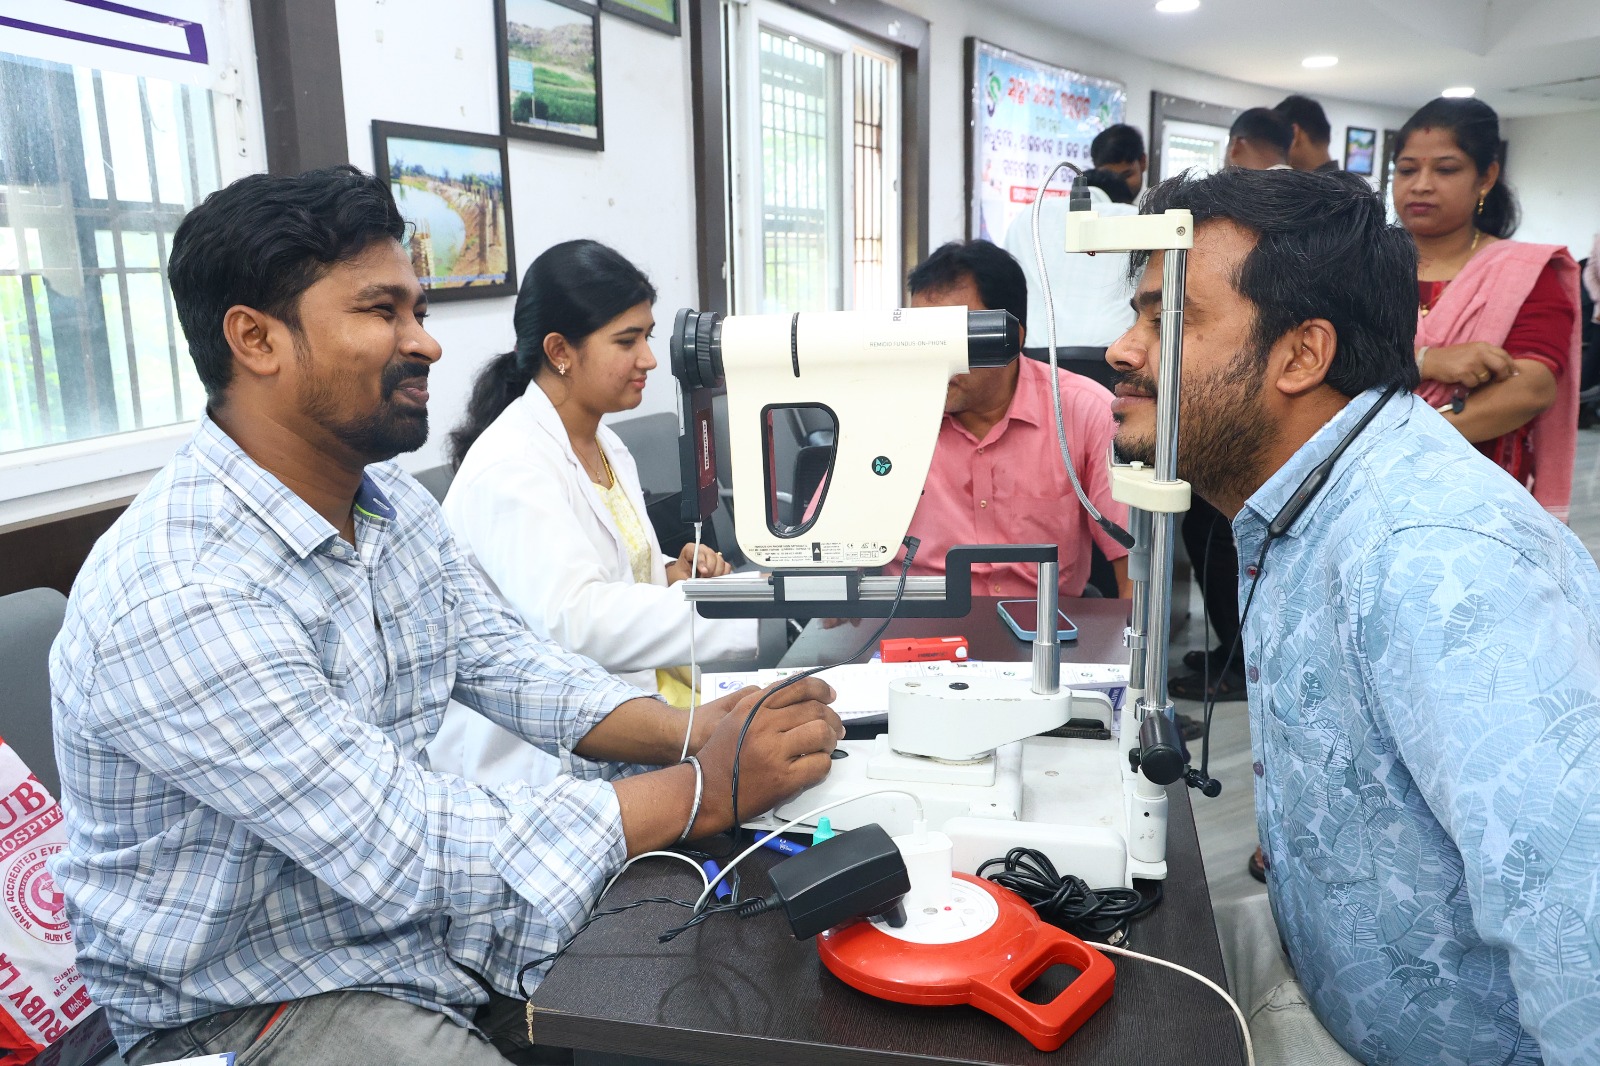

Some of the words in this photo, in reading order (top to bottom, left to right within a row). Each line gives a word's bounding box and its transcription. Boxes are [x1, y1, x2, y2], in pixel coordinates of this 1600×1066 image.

[6, 852, 37, 902] ACCREDITED
[10, 905, 32, 930] NABH
[45, 932, 63, 942] RUBY
[66, 972, 83, 985] Roa
[8, 985, 69, 1044] RUBY
